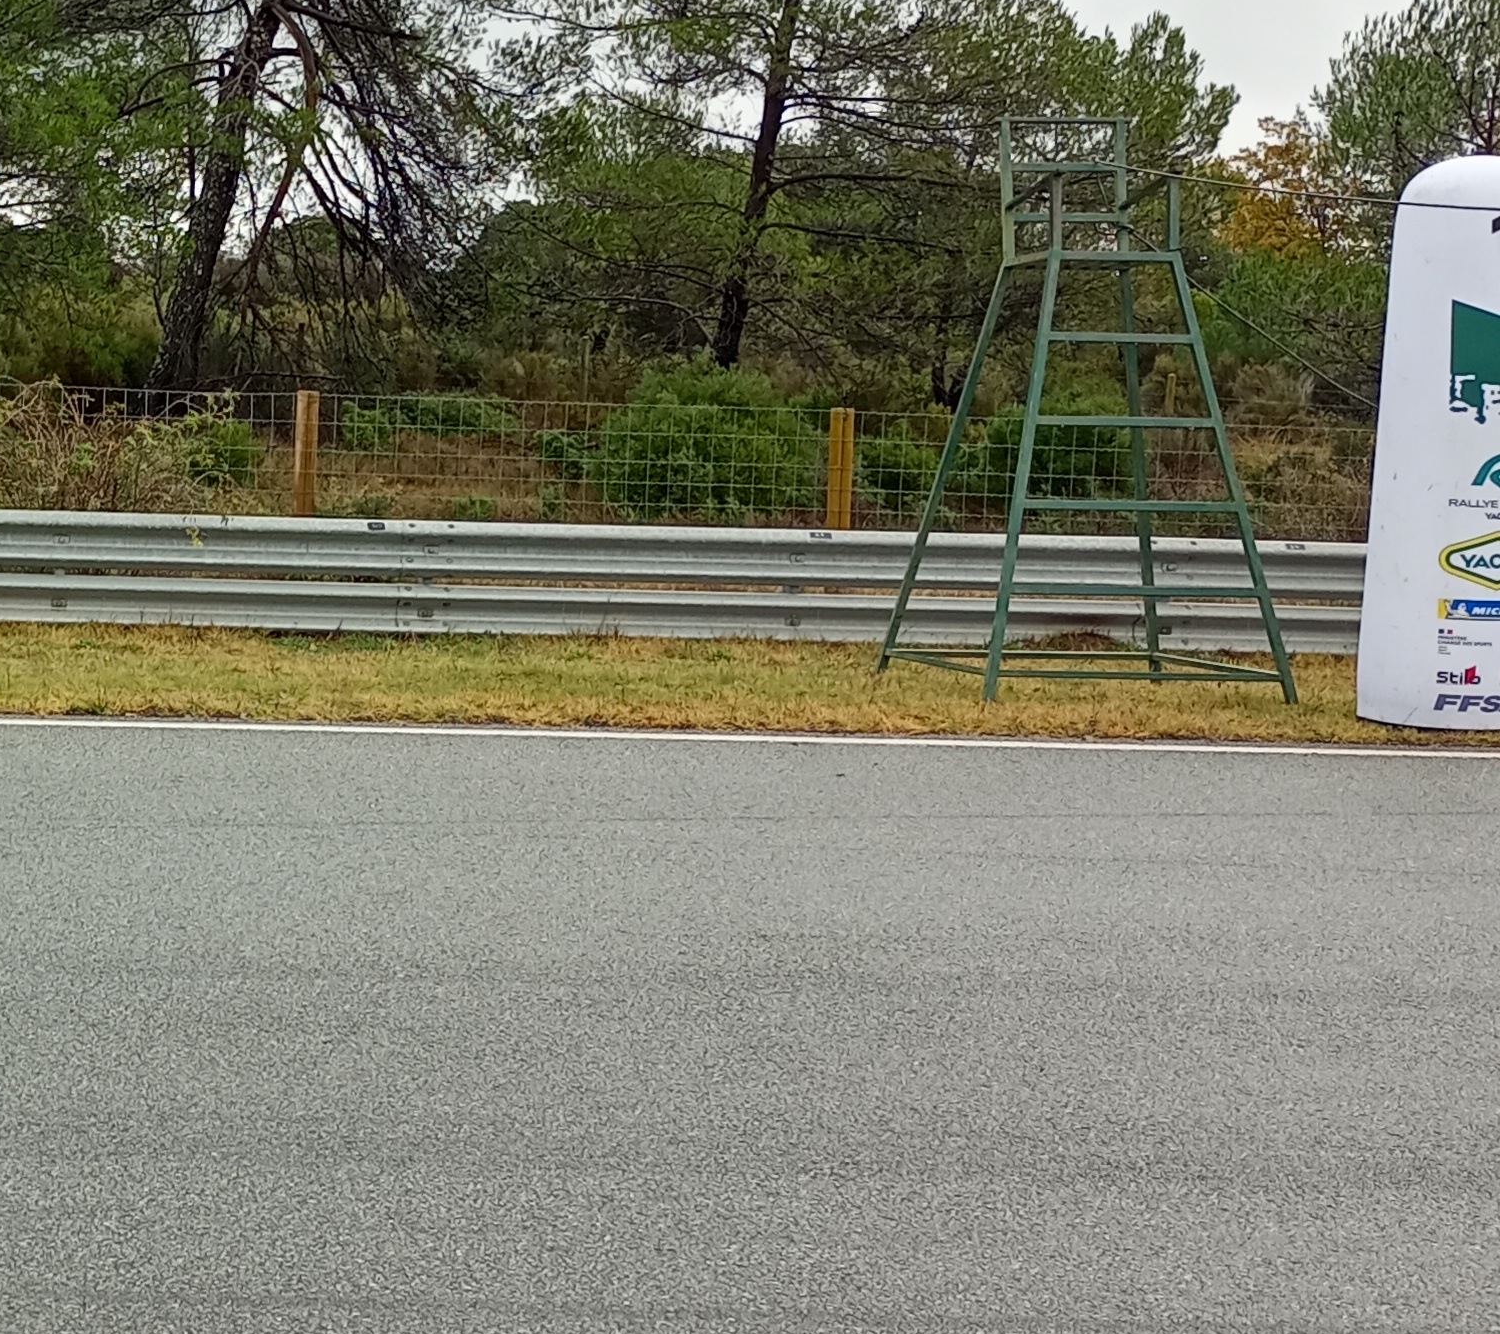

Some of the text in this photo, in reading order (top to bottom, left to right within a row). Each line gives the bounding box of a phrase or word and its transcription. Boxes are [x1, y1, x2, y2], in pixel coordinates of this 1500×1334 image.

[1448, 498, 1498, 509] RALLYE
[1471, 606, 1500, 616] MIC
[1436, 665, 1481, 685] Stilo
[1433, 693, 1500, 713] FFS
